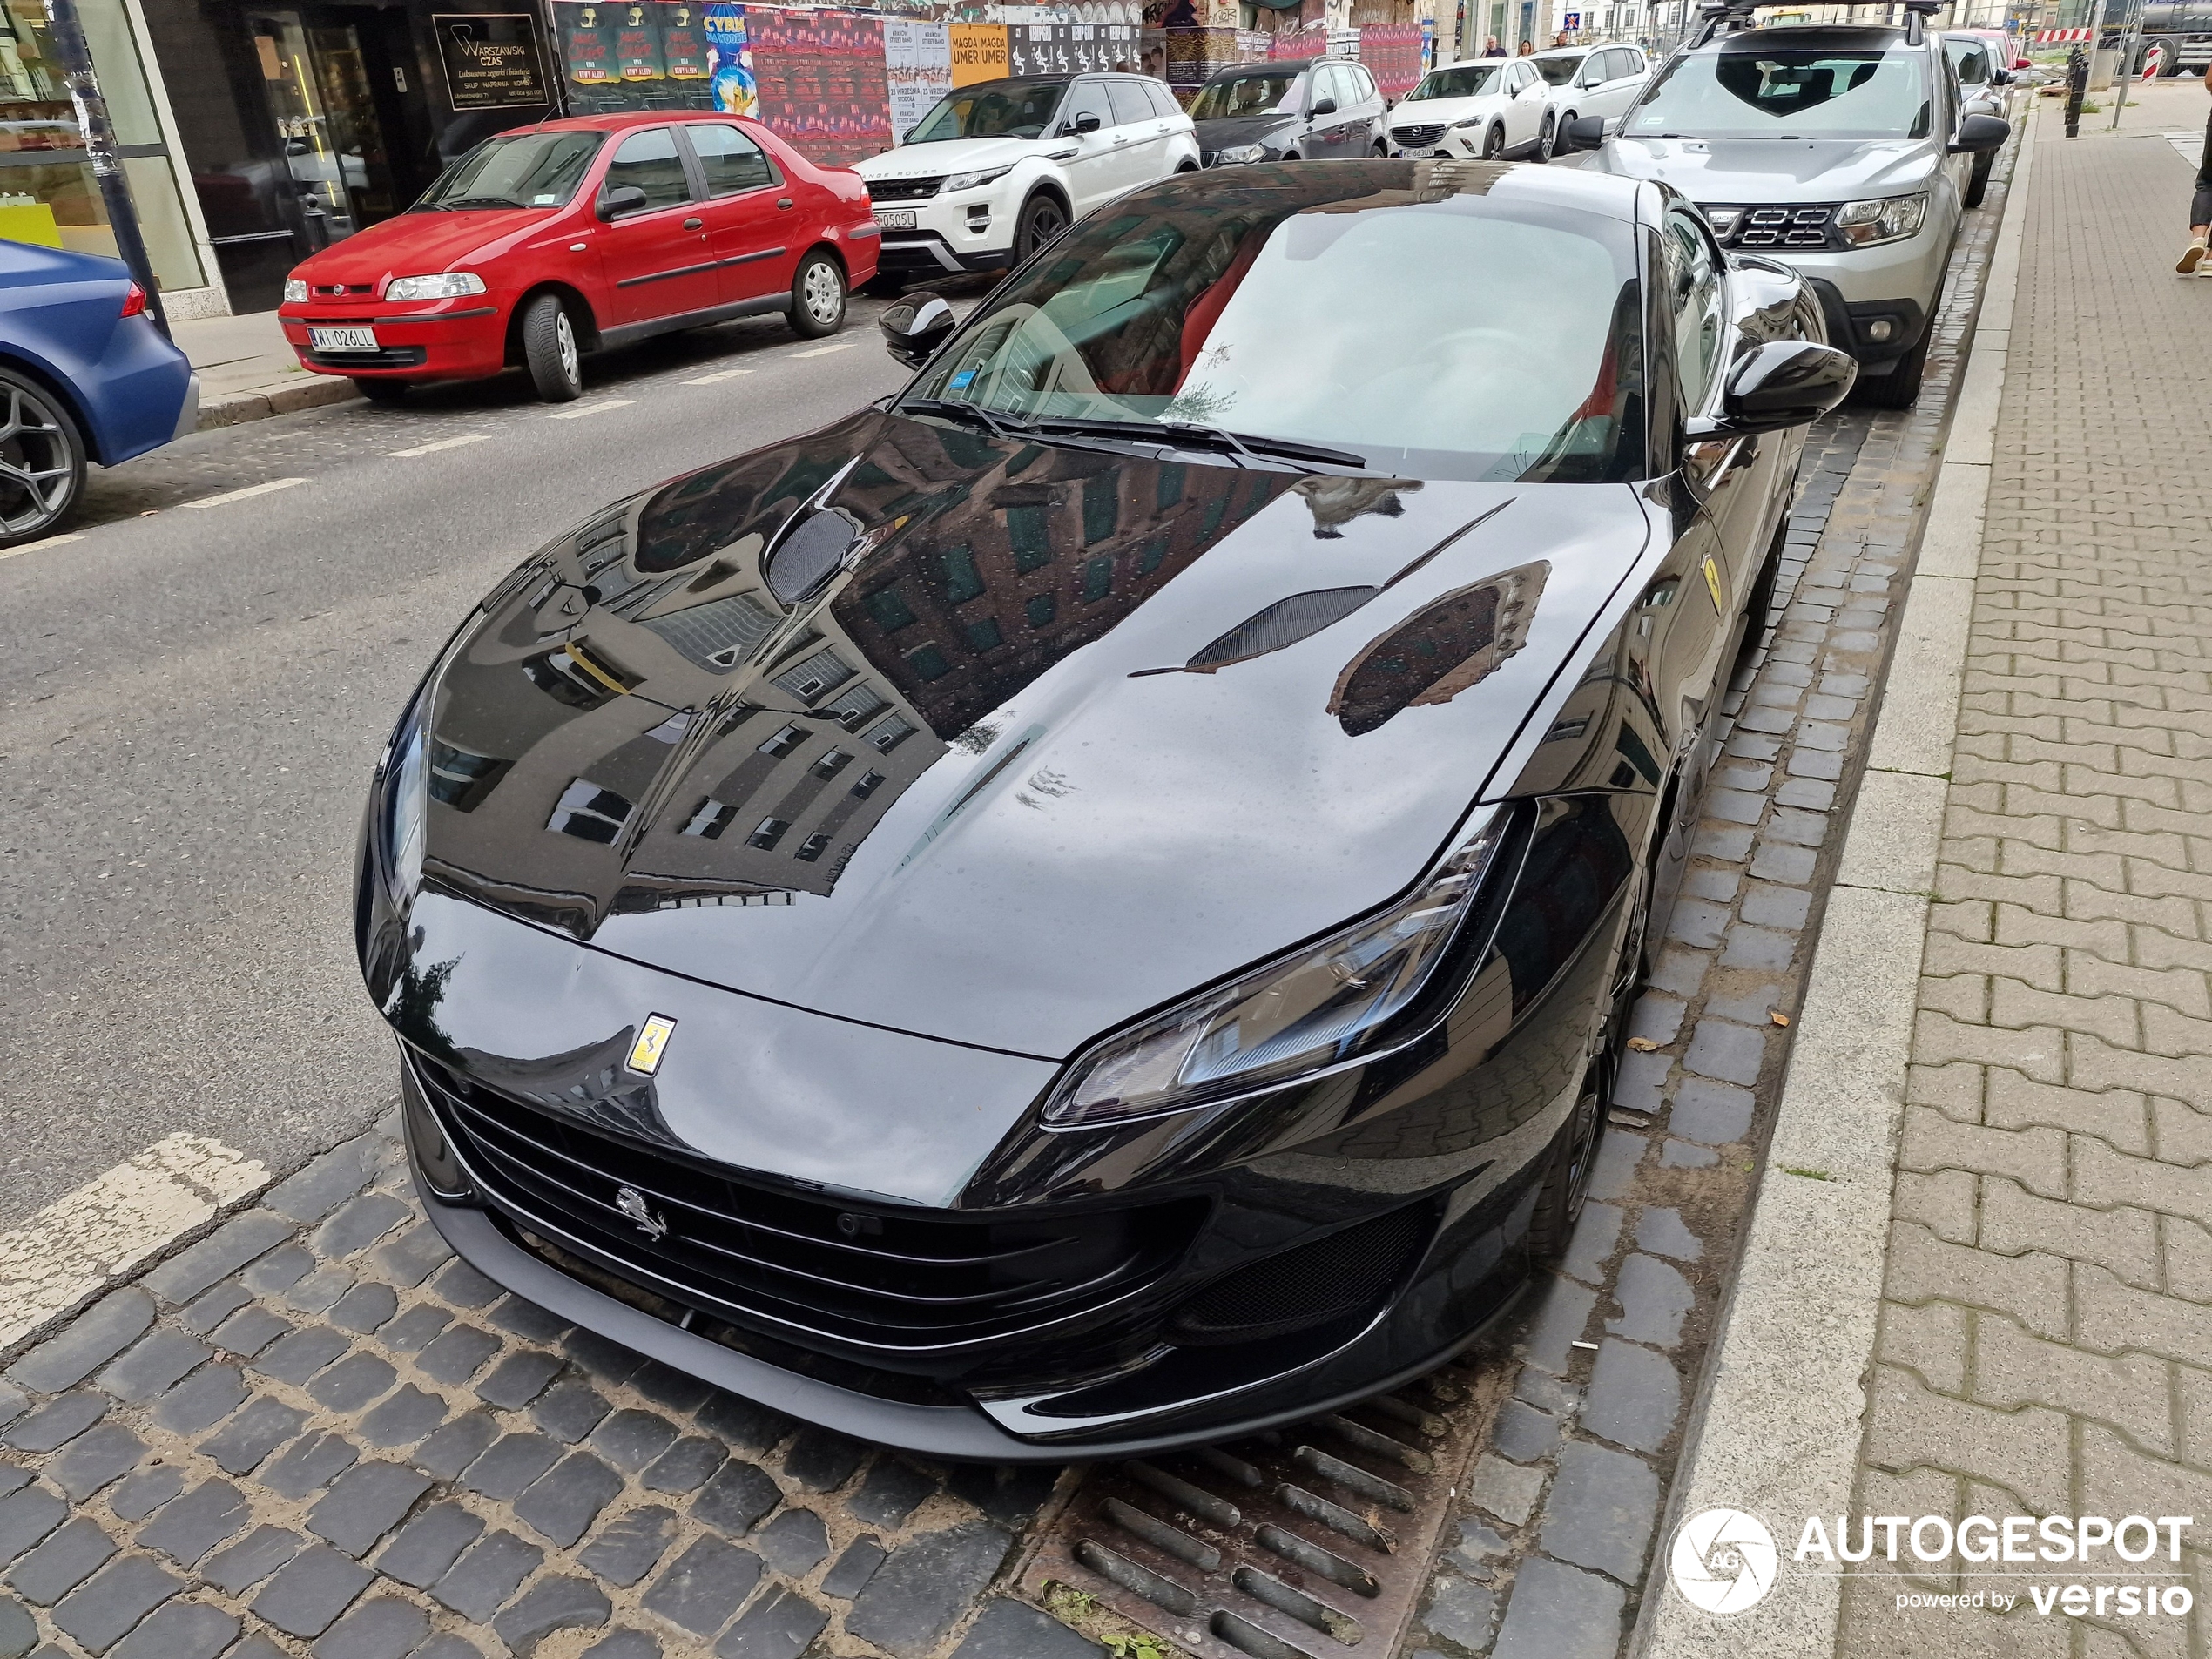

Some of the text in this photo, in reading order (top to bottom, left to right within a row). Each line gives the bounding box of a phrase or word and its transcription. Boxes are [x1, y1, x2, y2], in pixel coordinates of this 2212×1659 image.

[704, 16, 746, 32] CYRK
[718, 32, 747, 44] WODZIE
[952, 37, 978, 48] MAGDA
[981, 37, 1006, 48] MAGDA
[480, 57, 503, 66] CZAS
[954, 50, 979, 64] UMER
[982, 50, 1006, 64] UMER
[458, 69, 487, 78] Luksusowe
[487, 68, 505, 79] zegarki
[1413, 148, 1433, 157] 663UV
[883, 212, 914, 226] 0505L
[315, 330, 374, 347] WI 026LL
